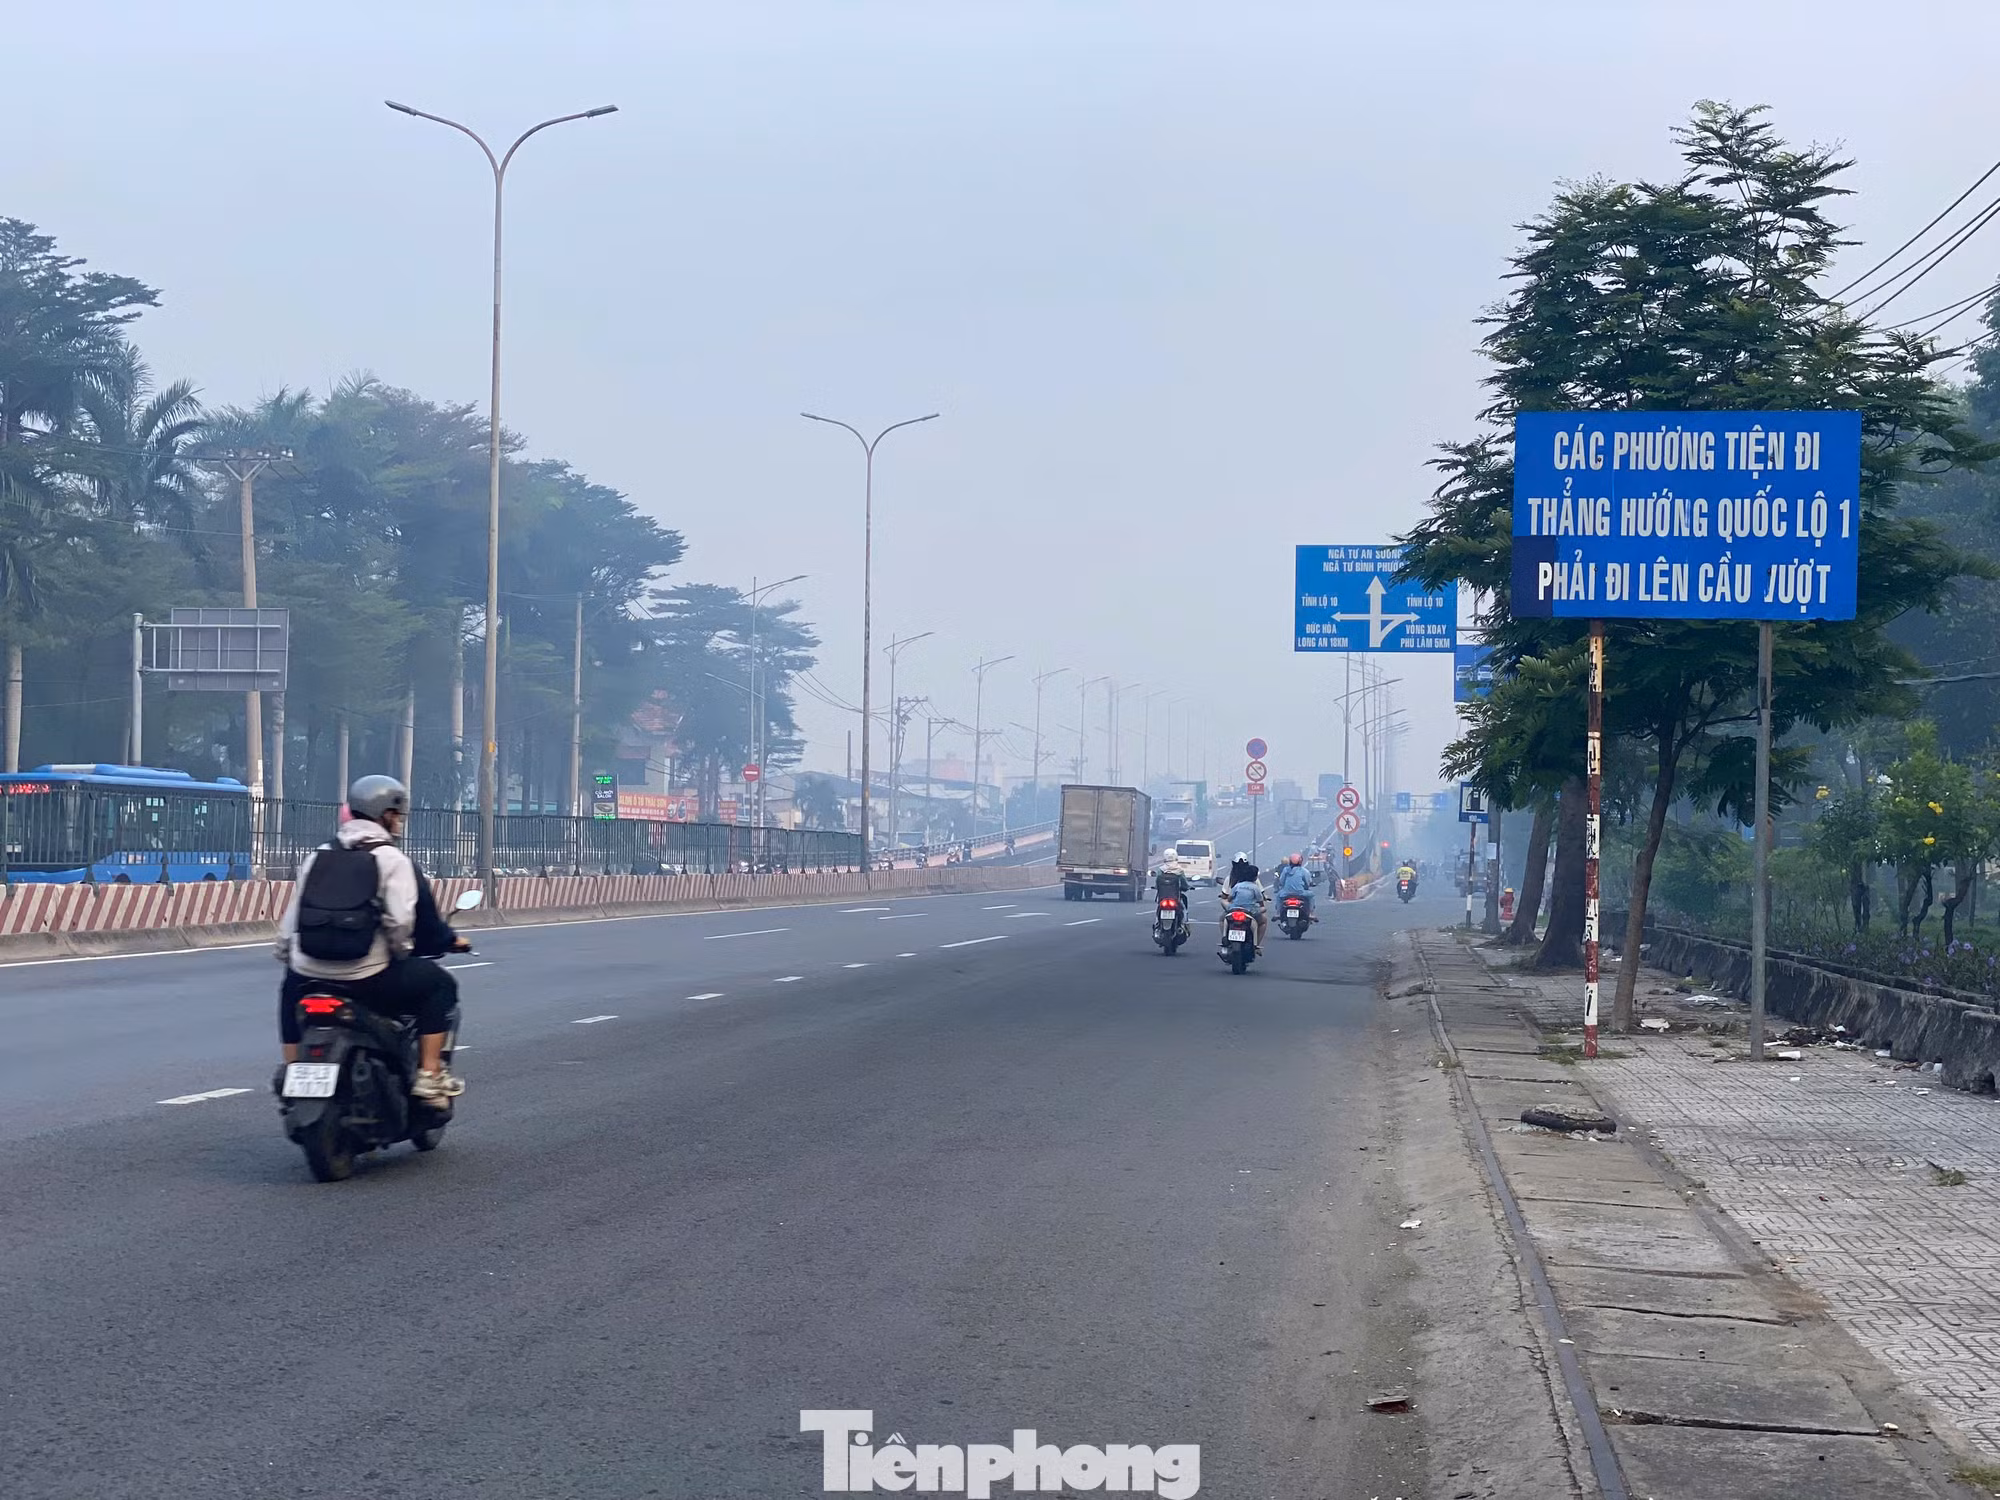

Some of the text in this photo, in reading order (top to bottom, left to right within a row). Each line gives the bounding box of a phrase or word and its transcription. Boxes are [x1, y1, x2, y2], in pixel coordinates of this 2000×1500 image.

[1553, 424, 1820, 480] CÁC PHƯƠNG TIỆN ĐI
[1528, 477, 1850, 548] THẲNG HƯỚNG QUỐC LỘ 1
[1328, 546, 1345, 559] NGÃ
[1348, 548, 1359, 559] TƯ
[1361, 548, 1373, 559] AN
[1323, 559, 1340, 572] NGÃ
[1343, 560, 1354, 572] TƯ
[1355, 559, 1374, 572] BÌNH
[1538, 549, 1596, 601] PHẢI
[1605, 562, 1630, 601] ĐI
[1638, 556, 1690, 602] LÊN
[1698, 552, 1752, 603] CẦU
[1330, 596, 1338, 607] 10
[1436, 597, 1444, 607] 10
[1427, 624, 1447, 634] XOAY
[1298, 637, 1316, 647] LONG
[1318, 637, 1328, 647] AN
[1434, 637, 1450, 648] 5KM
